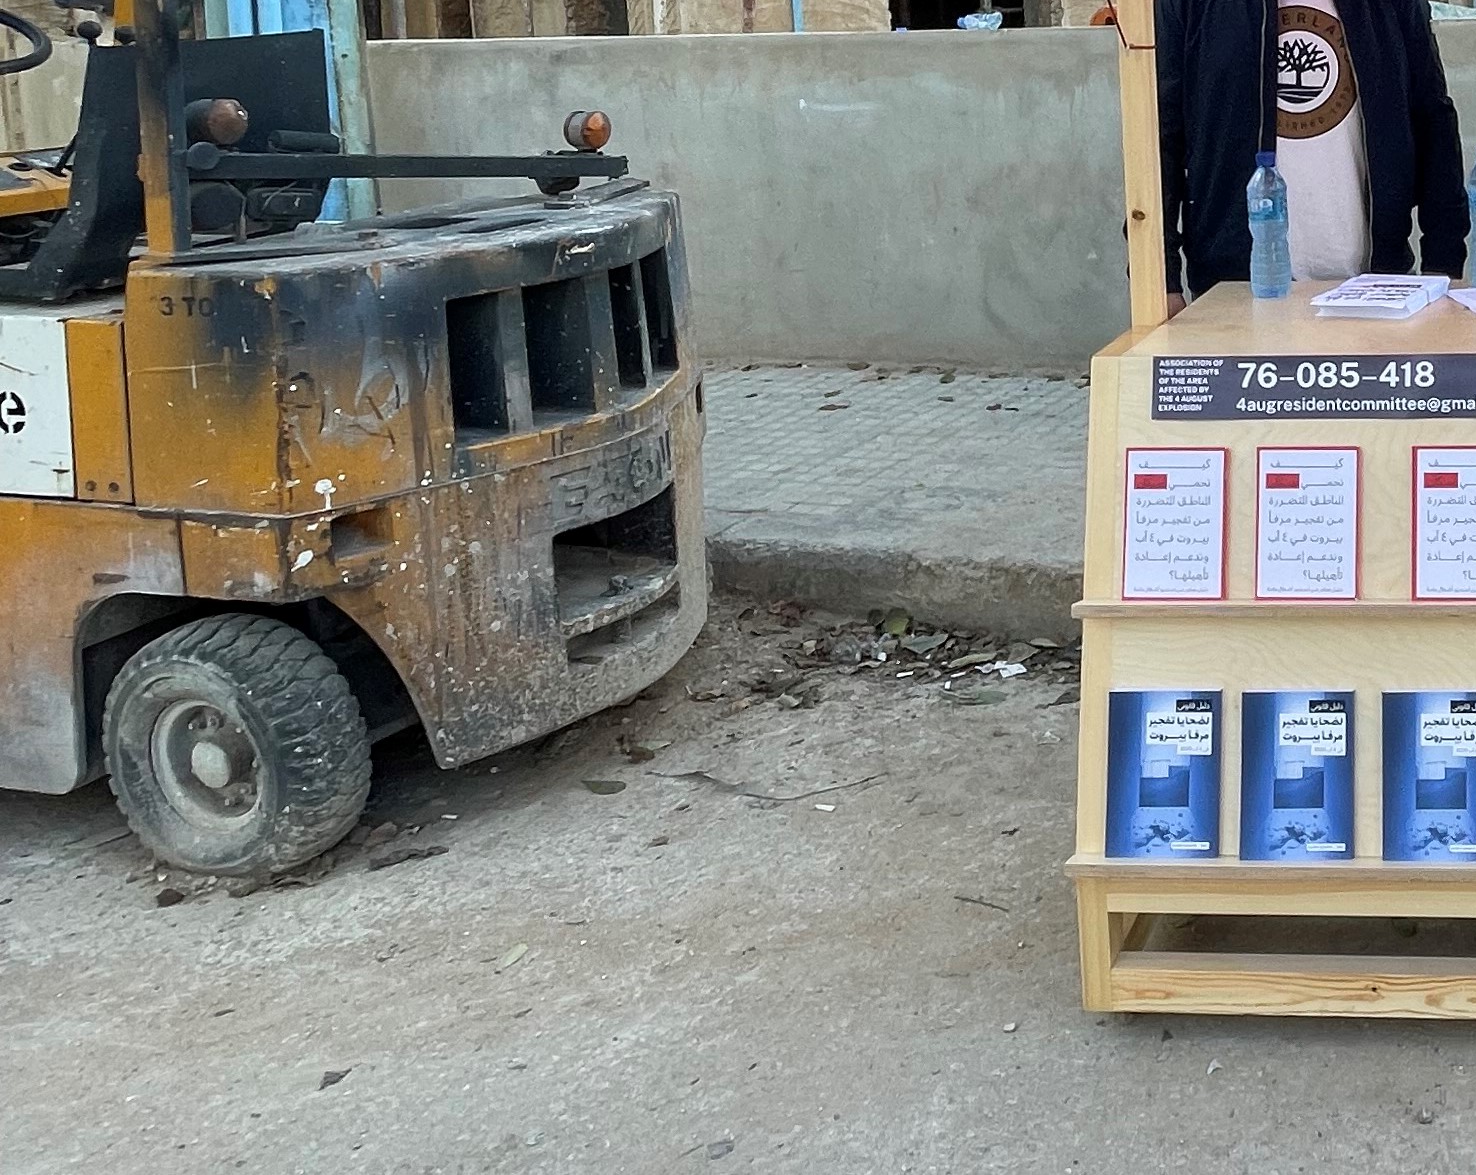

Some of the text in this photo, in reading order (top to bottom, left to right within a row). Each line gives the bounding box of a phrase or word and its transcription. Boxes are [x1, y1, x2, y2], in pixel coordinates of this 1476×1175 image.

[161, 296, 173, 316] 3
[1159, 359, 1224, 367] ASSOCIATION OF
[1158, 368, 1220, 376] THE RESIDENTS
[1236, 360, 1436, 389] 76-085-418
[1158, 377, 1208, 385] OF THE AREA
[1158, 386, 1210, 394] AFFECTED BY
[1158, 394, 1214, 403] THE 4 AUGUST
[1158, 403, 1203, 412] EXPLOSION
[1139, 459, 1211, 471] كيف
[1271, 458, 1344, 470] كيف
[1194, 518, 1210, 526] من
[1327, 517, 1343, 526] من
[1157, 534, 1173, 546] في
[1177, 535, 1209, 544] بيروت
[1290, 534, 1307, 546] في
[1310, 535, 1343, 544] بيروت
[1449, 533, 1466, 546] في
[1149, 716, 1209, 728] لضحايا تفجير
[1282, 717, 1343, 729] لضحايا تفجير
[1423, 717, 1450, 729] تفجير
[1150, 732, 1187, 742] بيروت
[1283, 733, 1321, 743] بيروت
[1424, 733, 1463, 744] بيروت
